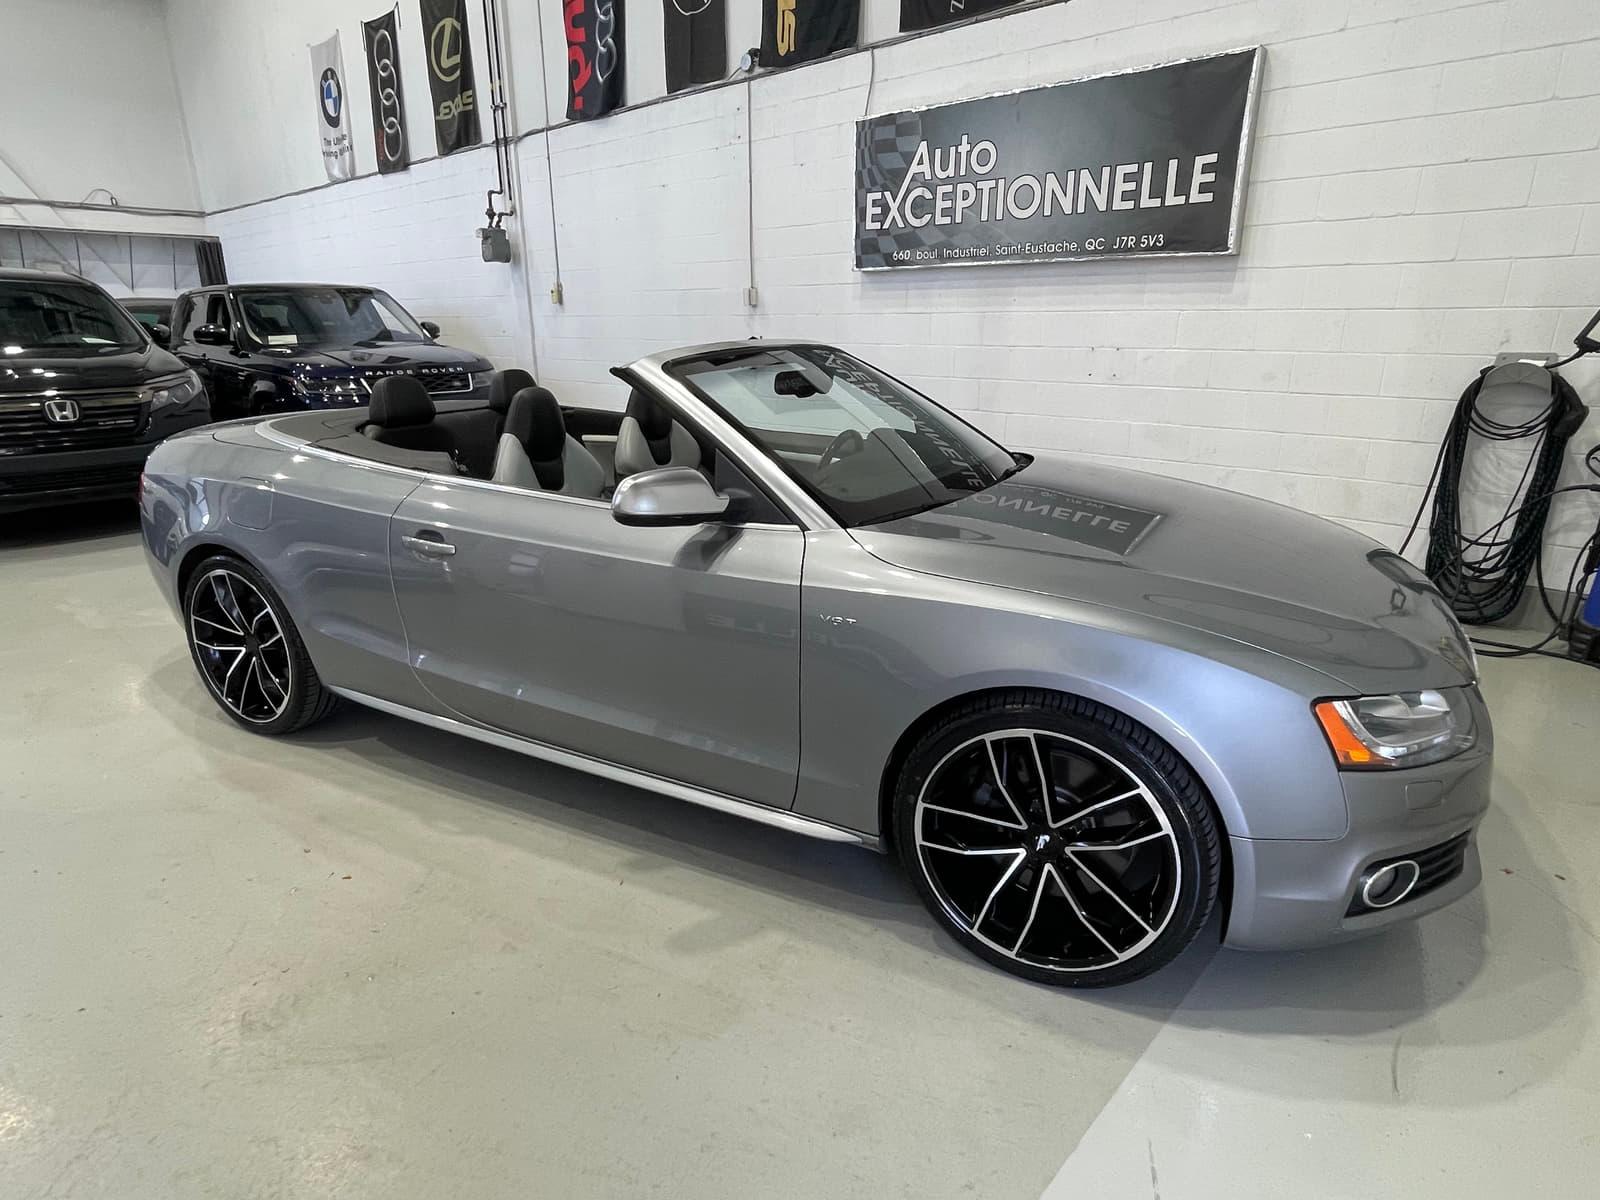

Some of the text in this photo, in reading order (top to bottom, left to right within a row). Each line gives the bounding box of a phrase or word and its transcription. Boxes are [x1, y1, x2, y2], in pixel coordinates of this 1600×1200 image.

[905, 133, 998, 183] Auto
[865, 152, 1219, 231] EXCEPTIONNELLE
[1085, 237, 1106, 251] QC
[1113, 236, 1136, 250] J7R
[1140, 234, 1165, 248] 5V3
